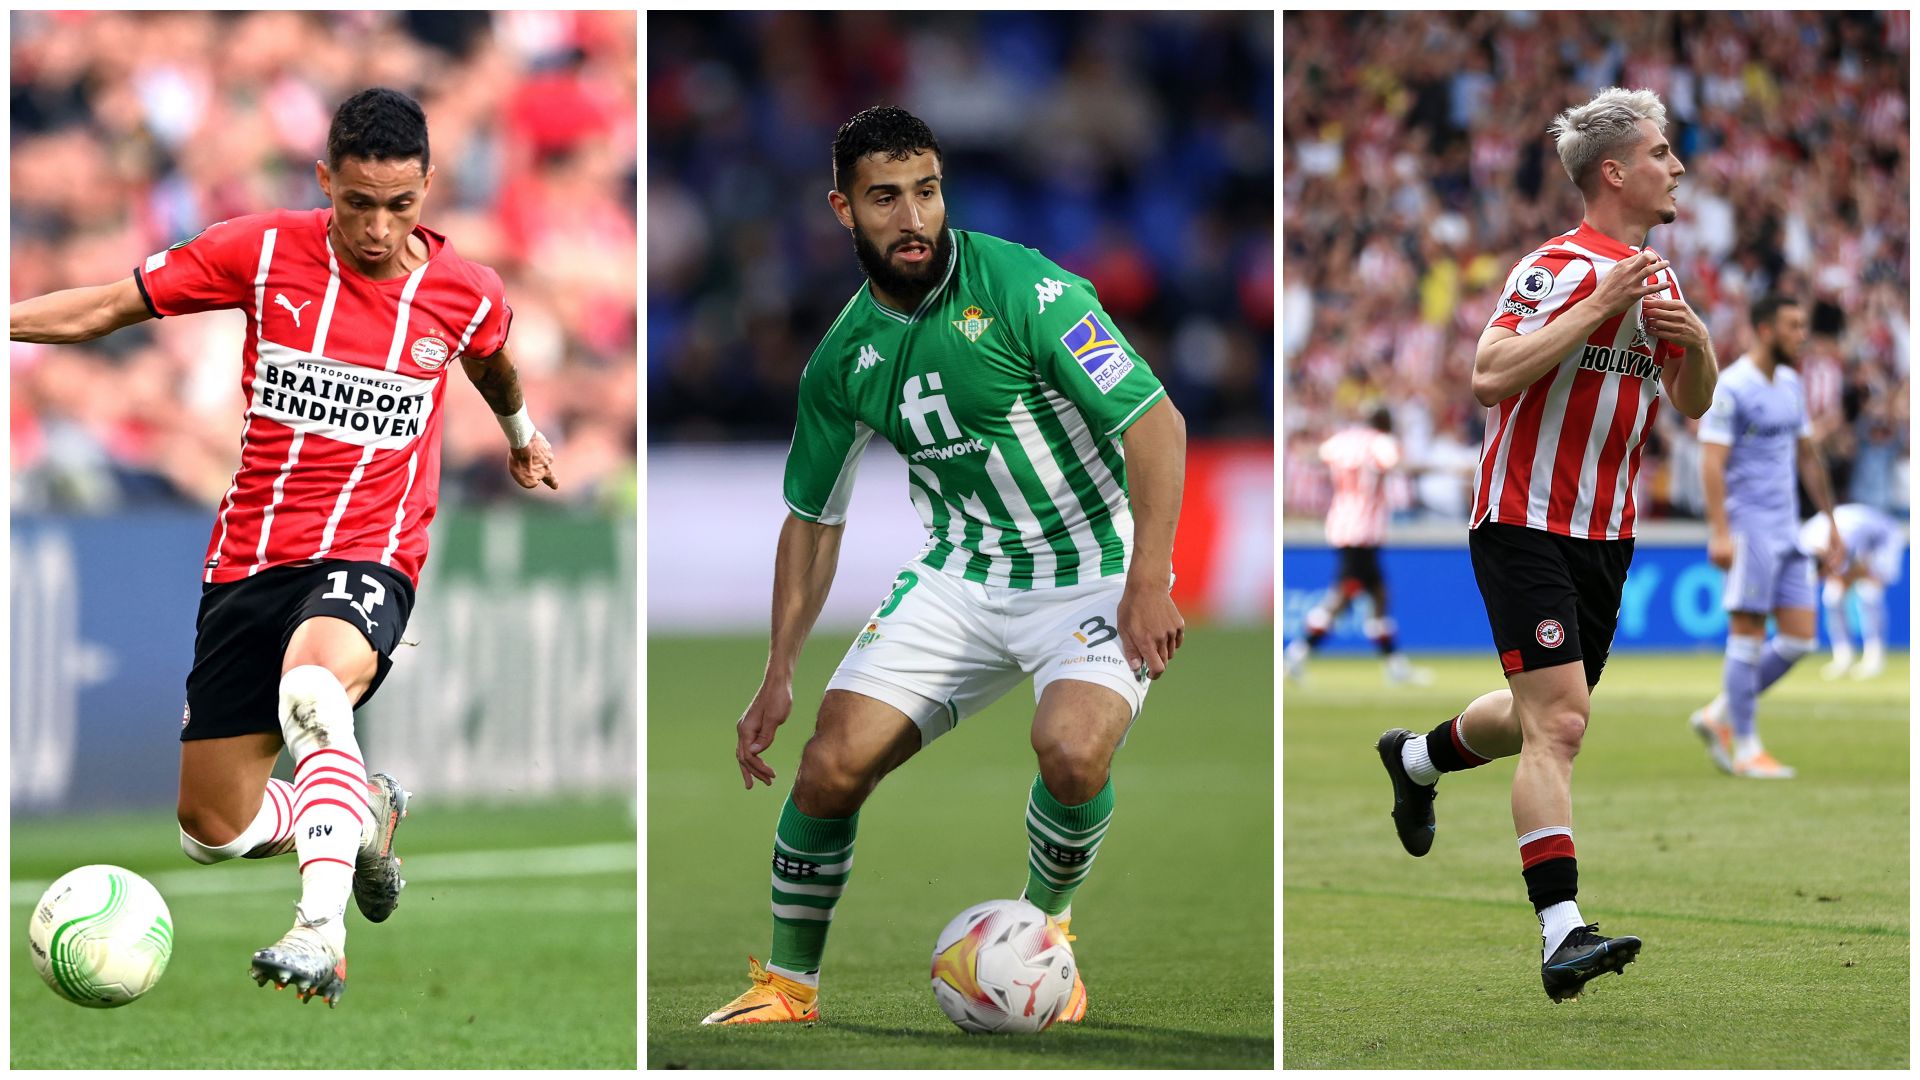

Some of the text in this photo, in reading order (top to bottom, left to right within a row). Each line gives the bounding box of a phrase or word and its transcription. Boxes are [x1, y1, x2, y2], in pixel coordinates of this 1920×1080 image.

[297, 362, 402, 393] METROPOOLREGIO
[1094, 353, 1128, 386] REALE
[1101, 361, 1132, 392] SEGUROS
[266, 365, 424, 415] BRAINPORT
[262, 387, 418, 437] EINDHOVEN
[899, 371, 963, 446] fi
[911, 438, 988, 462] network
[322, 570, 386, 614] 17
[308, 824, 333, 840] PSV
